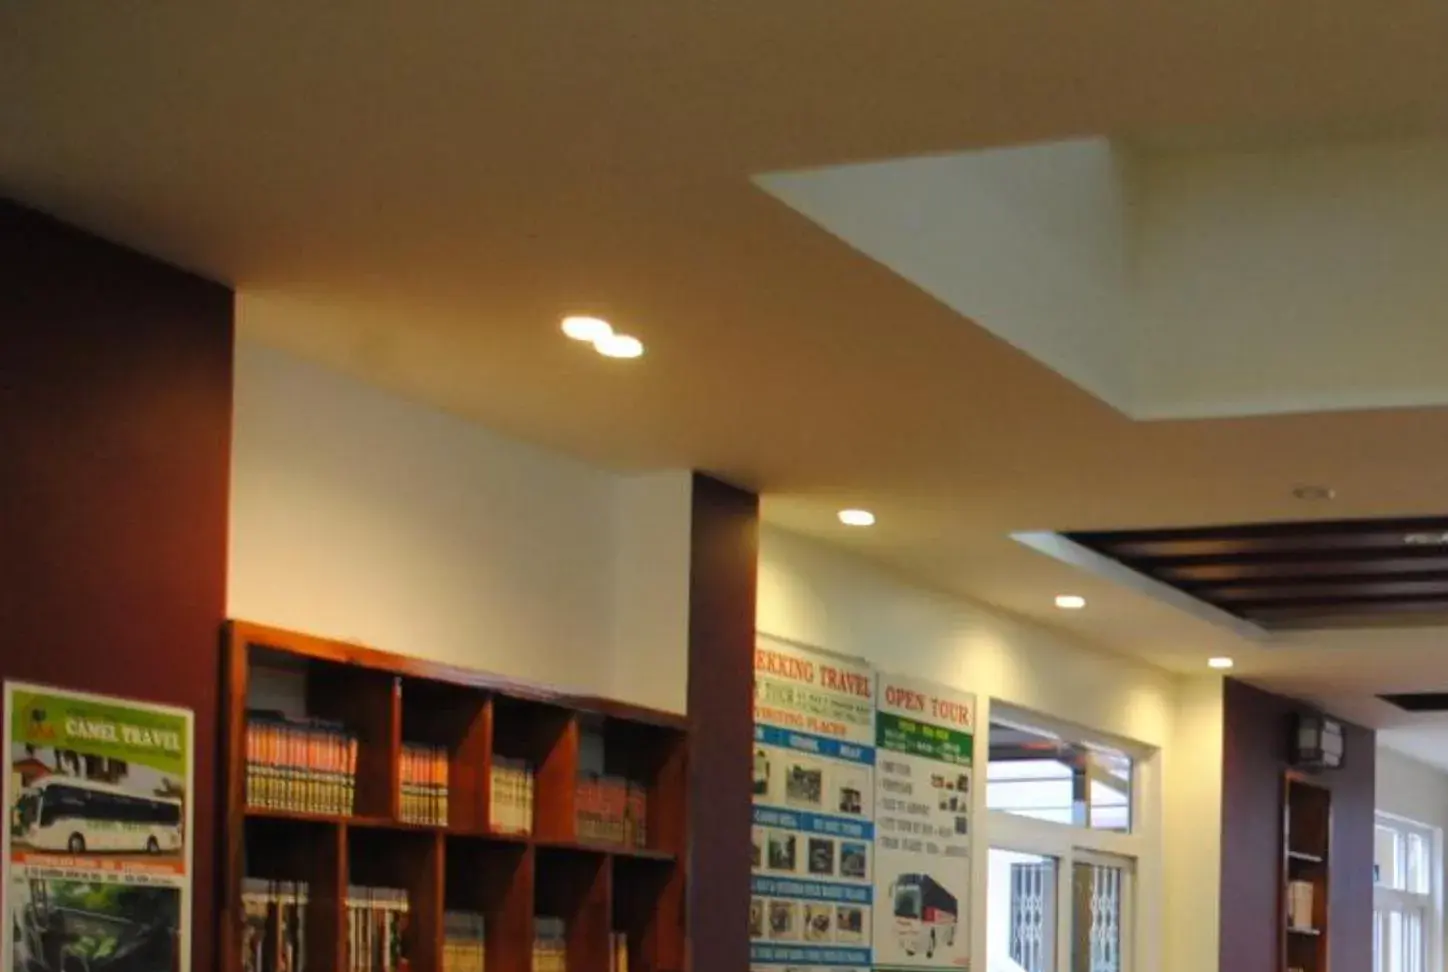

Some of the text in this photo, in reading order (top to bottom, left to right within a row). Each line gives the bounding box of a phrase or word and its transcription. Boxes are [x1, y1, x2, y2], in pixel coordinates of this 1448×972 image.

[756, 651, 870, 697] EKKING TRAVEL
[885, 685, 924, 711] OPEN
[931, 696, 970, 727] TOUR
[66, 717, 118, 742] CAMEL
[121, 724, 181, 751] TRAVEL
